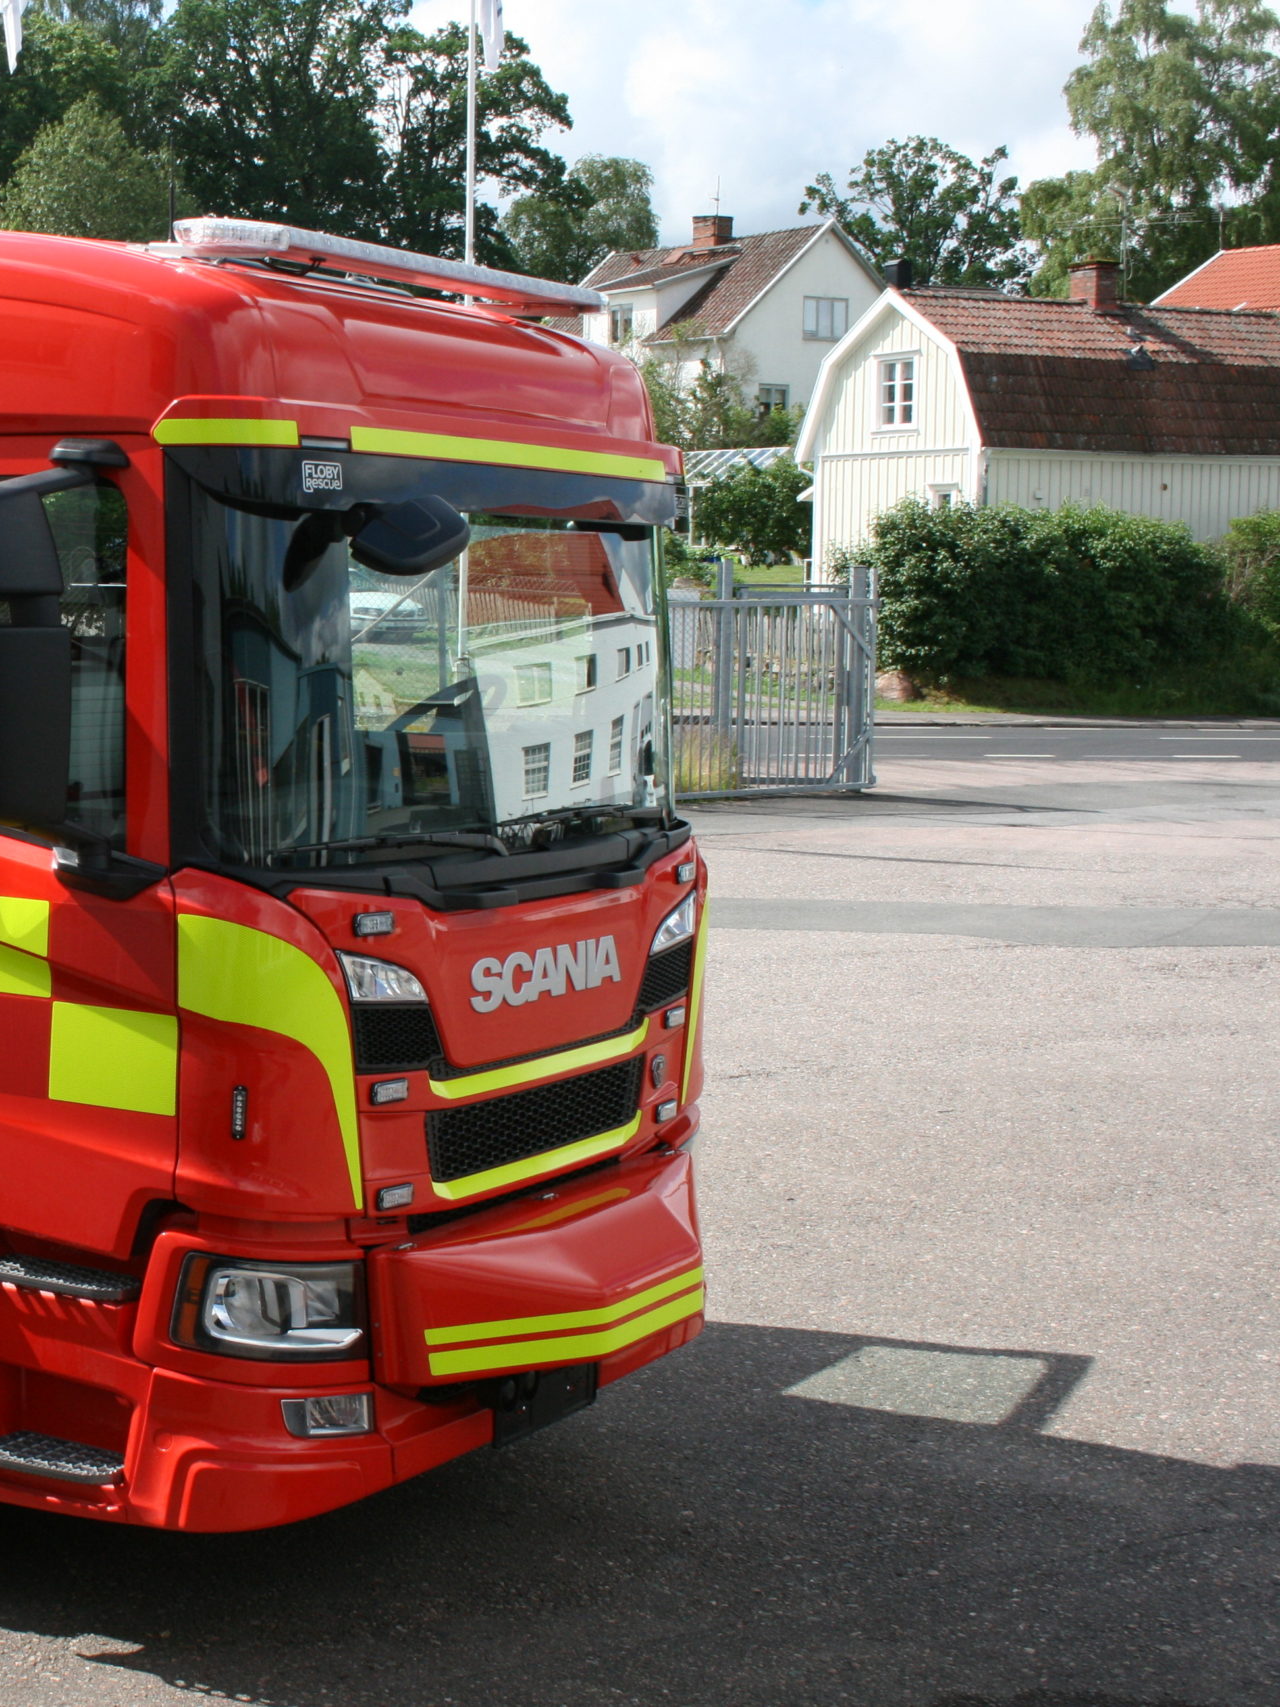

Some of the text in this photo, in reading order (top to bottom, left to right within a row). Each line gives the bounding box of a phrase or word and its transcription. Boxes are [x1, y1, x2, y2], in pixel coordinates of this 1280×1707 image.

[304, 464, 339, 479] FLOBY
[305, 478, 340, 491] Rescue
[469, 934, 622, 1014] SCANIA
